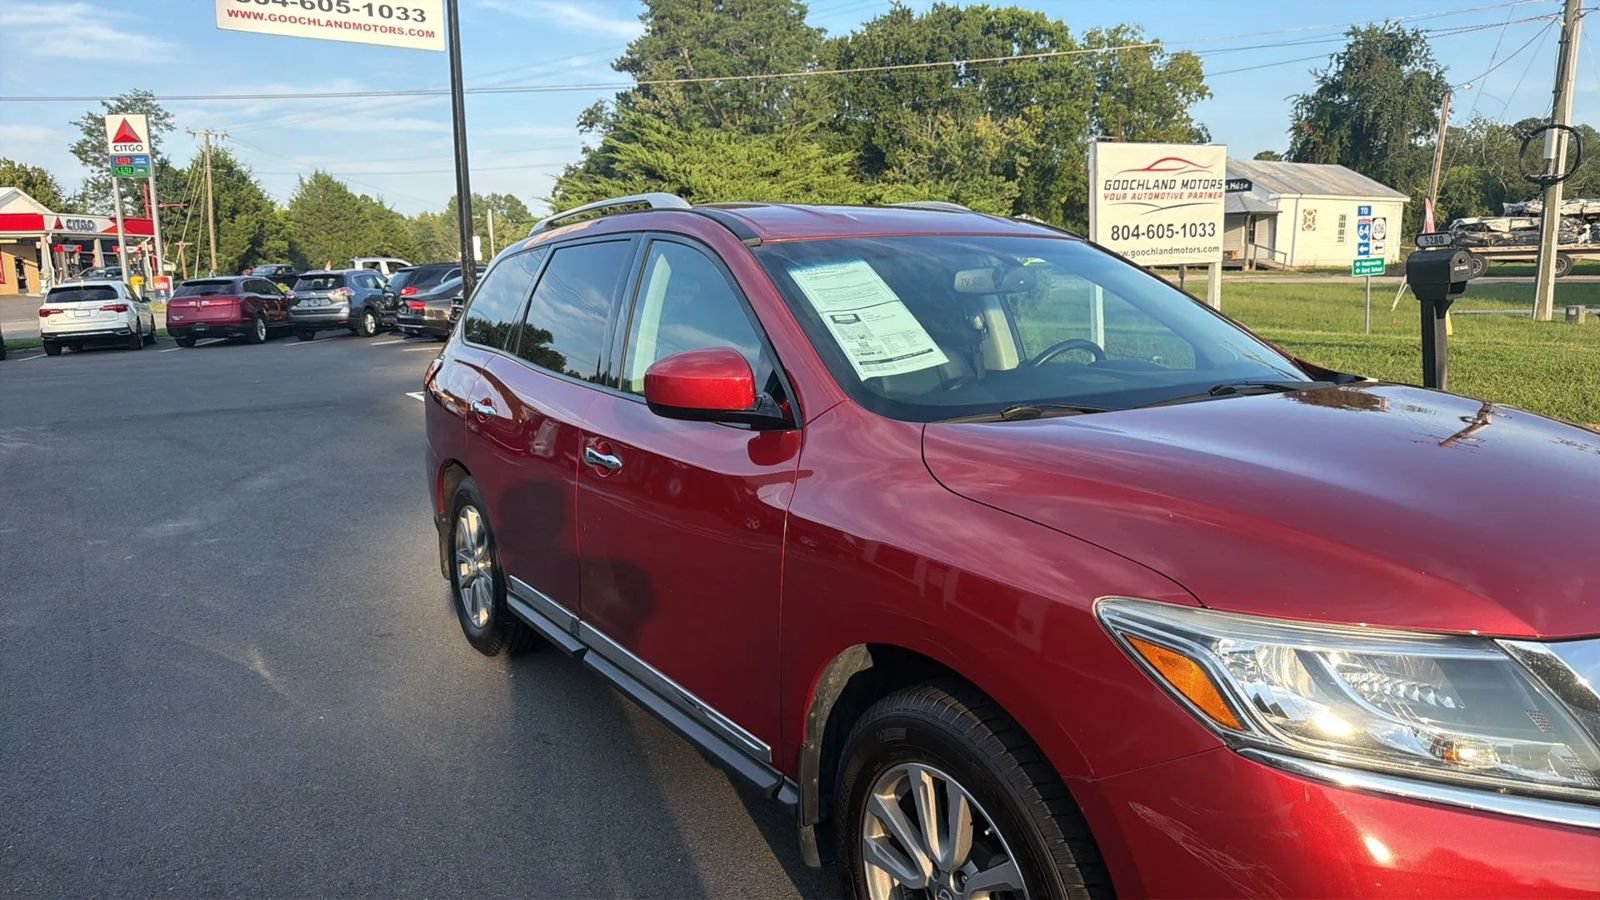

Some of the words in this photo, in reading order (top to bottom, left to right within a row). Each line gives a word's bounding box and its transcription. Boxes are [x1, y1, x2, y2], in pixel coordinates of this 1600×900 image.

[234, 0, 427, 23] 4-605-1033
[226, 9, 435, 38] WWW.GOOCHLANDMOTORS.COM
[113, 144, 144, 152] CITGO
[1104, 179, 1177, 191] GOOCHLAND
[1180, 178, 1224, 190] MOTORS
[1103, 193, 1127, 201] YOUR
[1130, 192, 1184, 200] AUTOMOTIVE
[1187, 191, 1223, 200] PARTNER
[1360, 207, 1369, 215] TO
[66, 218, 96, 231] CITGO
[1359, 223, 1370, 236] 64
[1111, 222, 1216, 241] 804-605-1033
[1424, 235, 1444, 245] 5280
